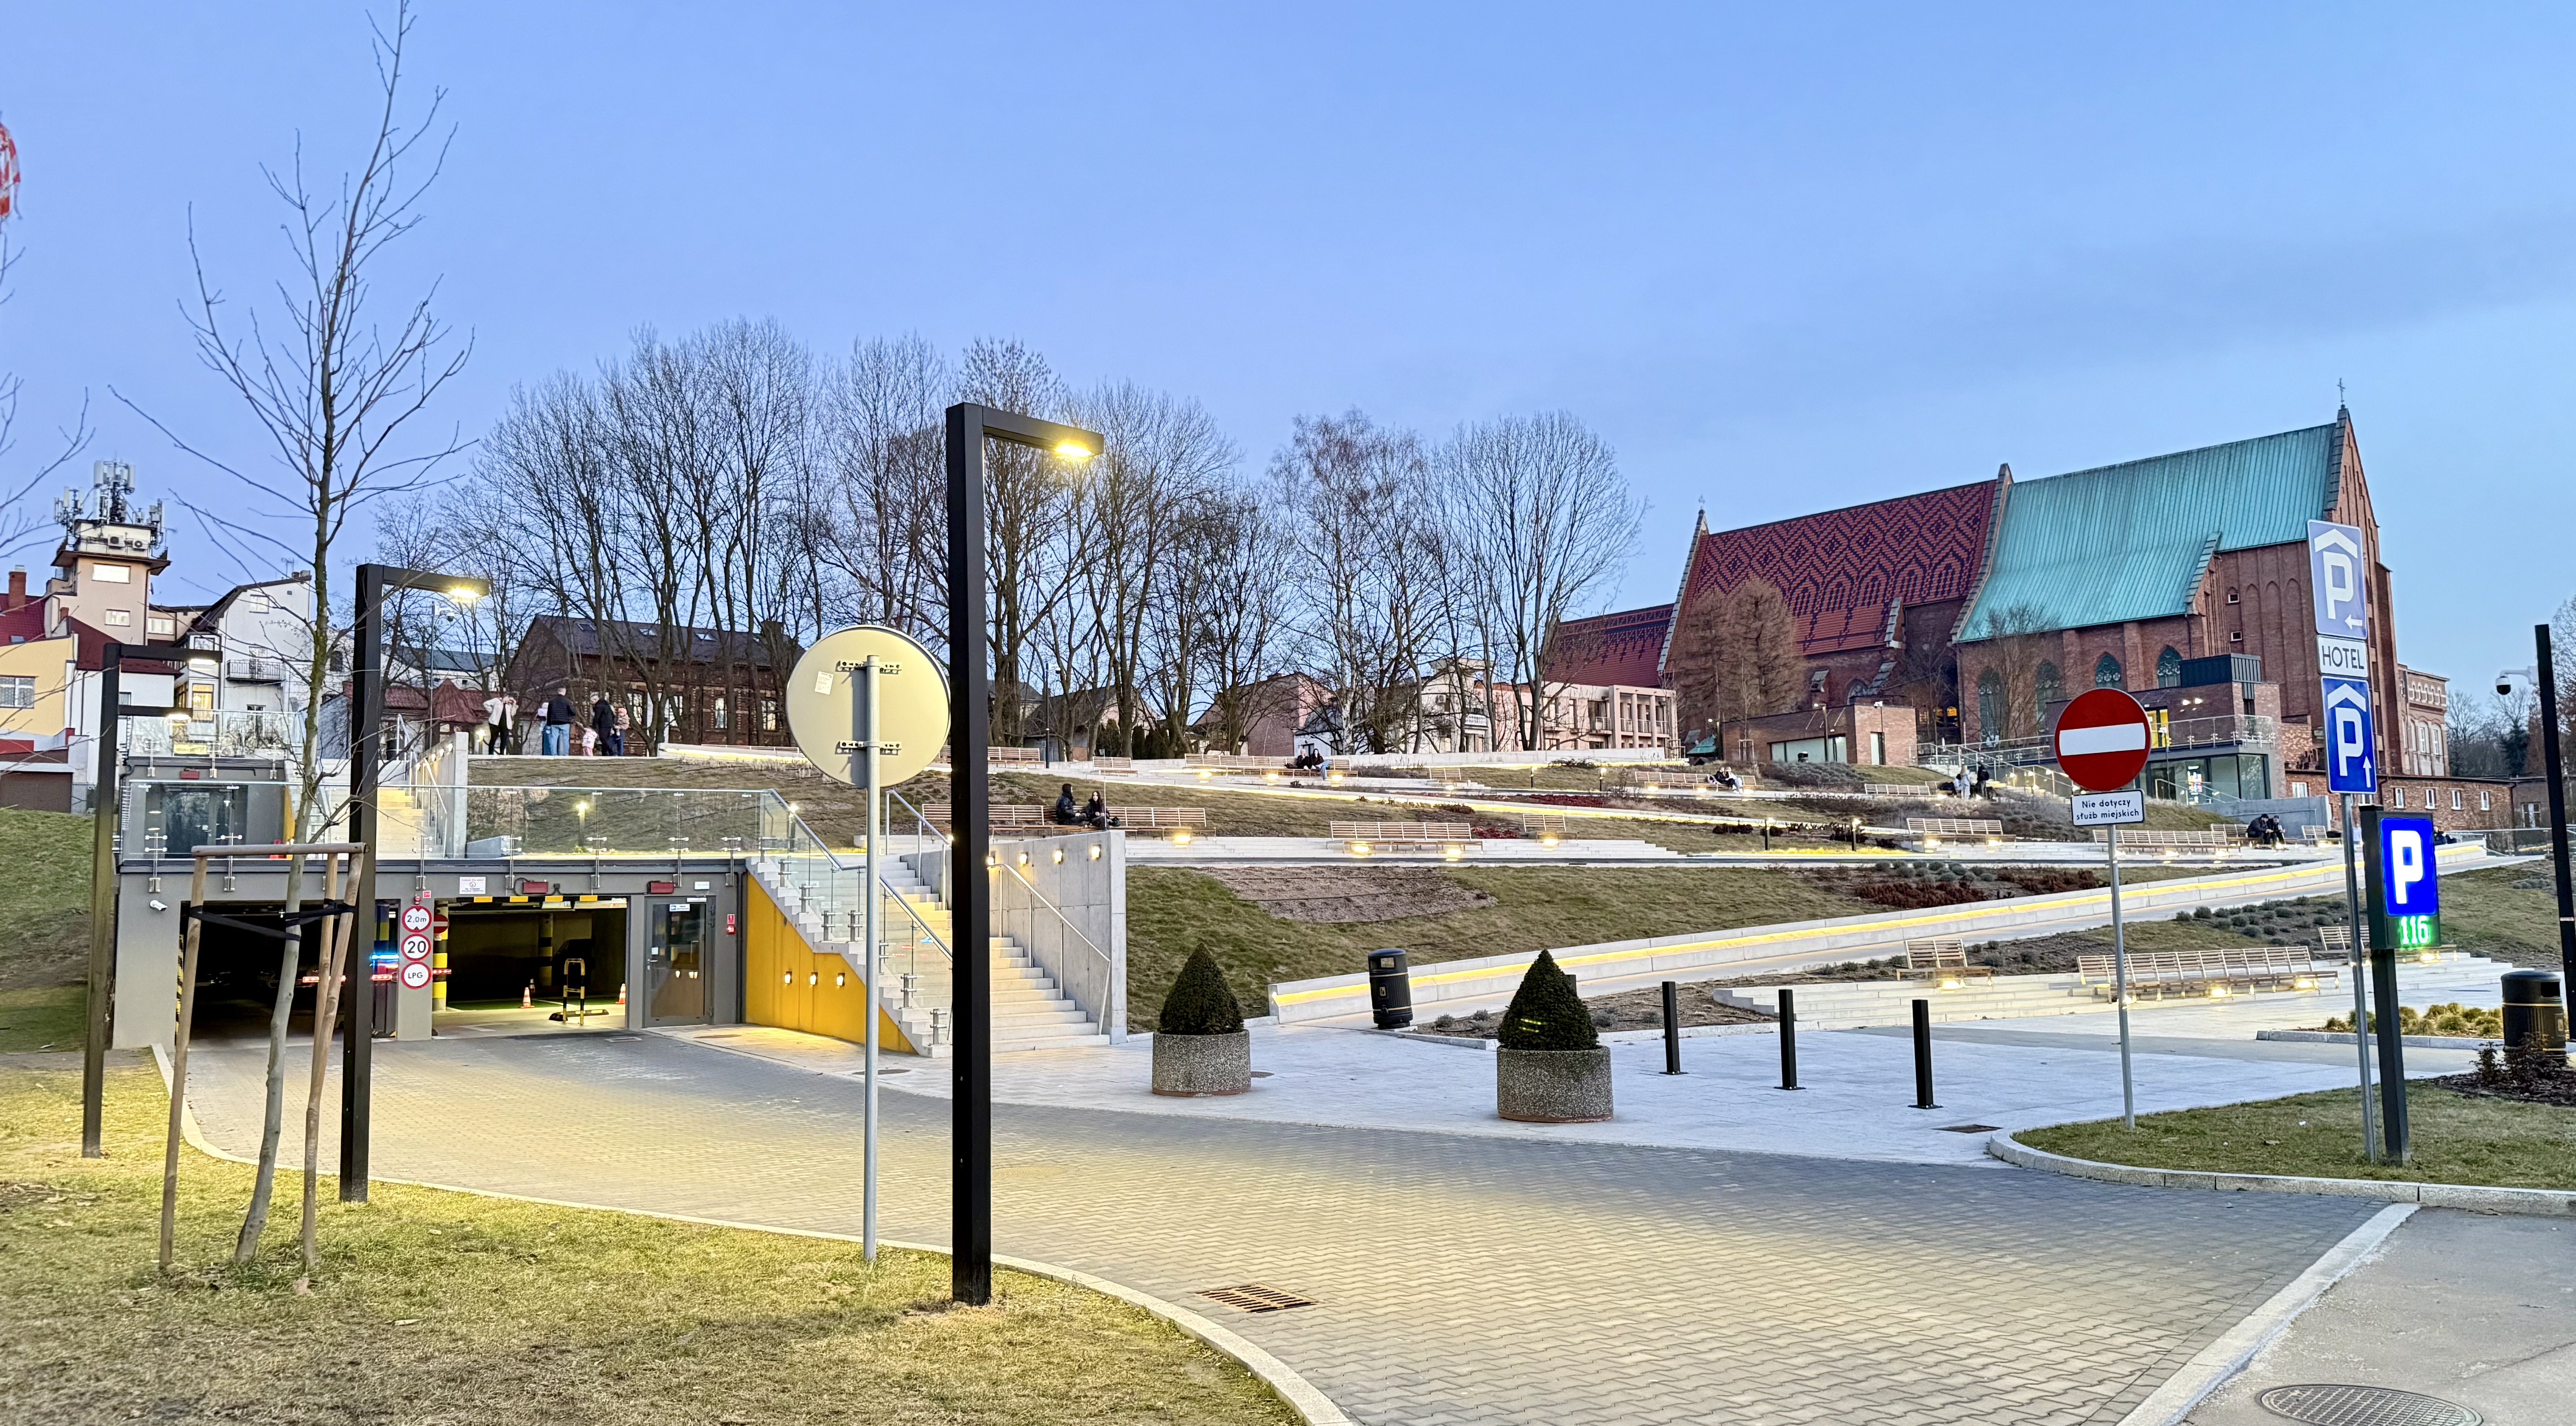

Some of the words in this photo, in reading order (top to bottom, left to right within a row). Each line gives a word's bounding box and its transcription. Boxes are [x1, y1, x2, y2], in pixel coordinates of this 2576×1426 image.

[2323, 551, 2354, 620] P
[2322, 645, 2365, 670] HOTEL
[2335, 707, 2364, 776] P
[2076, 811, 2097, 820] służb
[2101, 809, 2139, 820] miejskich
[2099, 799, 2130, 809] dotyczy
[2391, 830, 2423, 904] P
[2400, 915, 2431, 945] 116
[407, 940, 426, 953] 20
